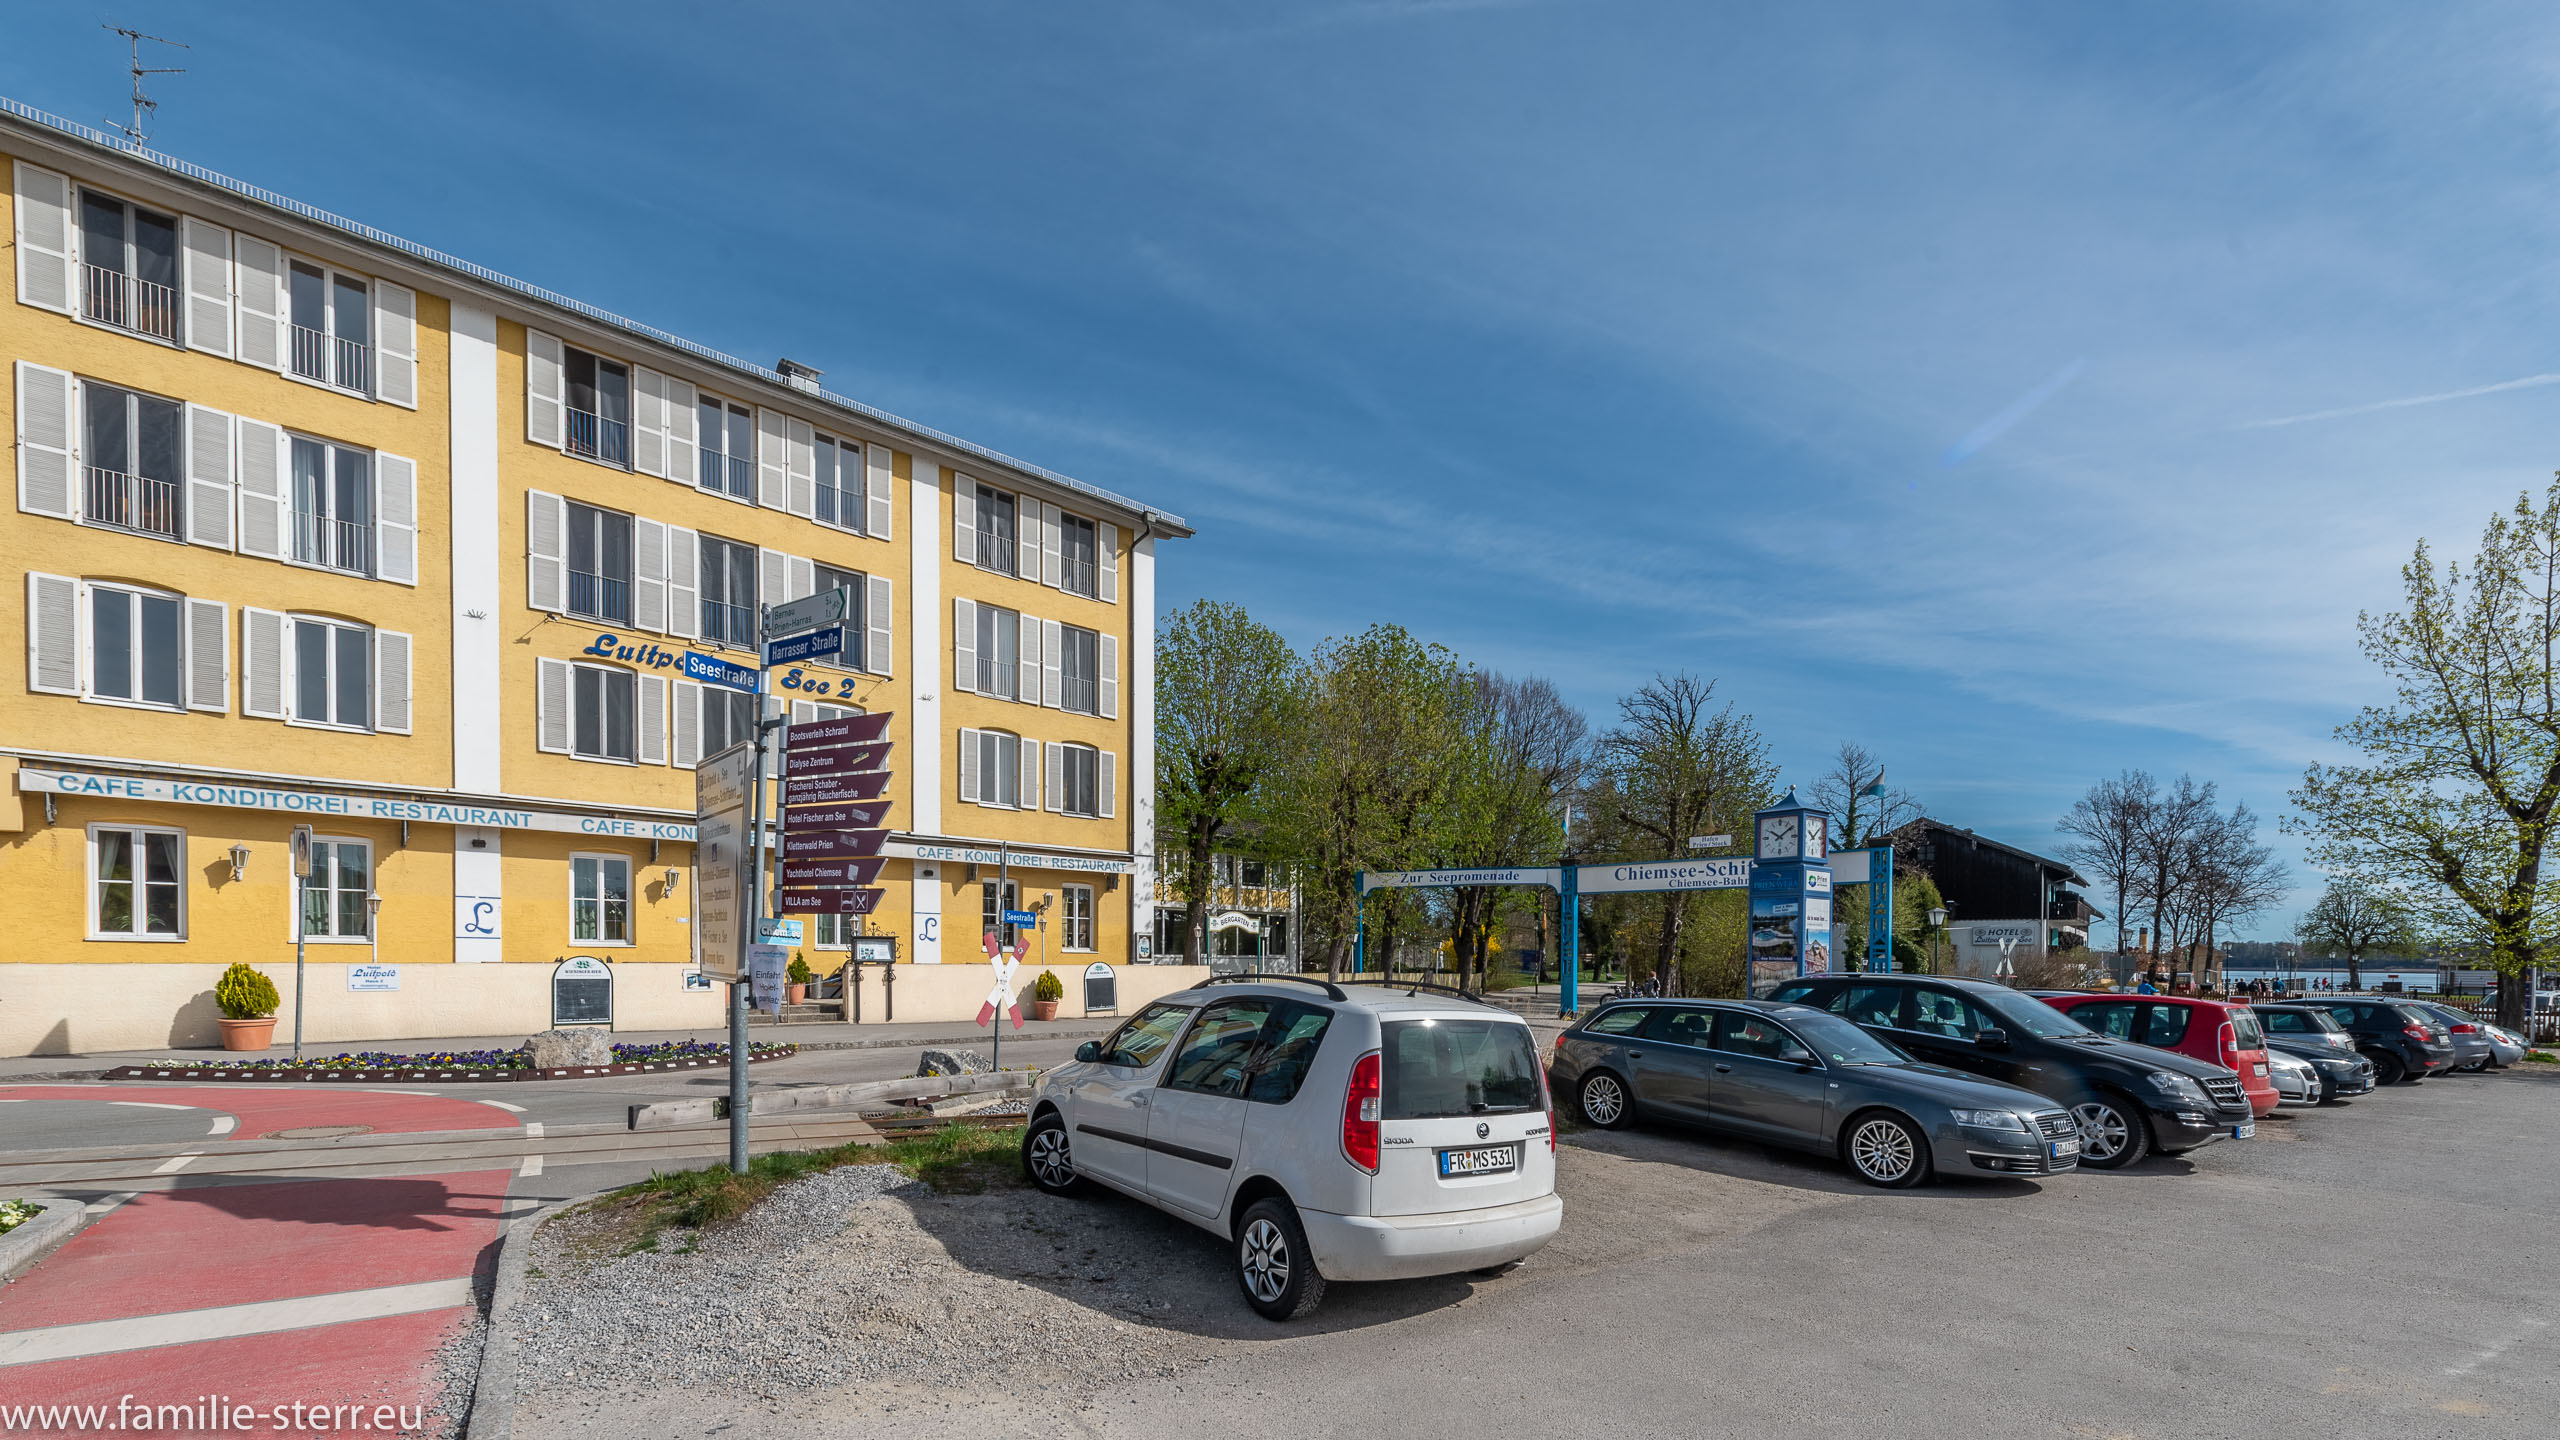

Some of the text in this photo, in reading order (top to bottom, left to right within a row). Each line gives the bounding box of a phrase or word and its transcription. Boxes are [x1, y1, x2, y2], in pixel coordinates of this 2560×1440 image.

[774, 608, 796, 620] Bernau
[774, 615, 812, 632] Prien-Harras
[584, 634, 684, 669] Luitpo
[771, 632, 839, 661] Harrasser Straße
[690, 656, 754, 687] Seestraße
[781, 668, 856, 699] See 2
[790, 725, 849, 741] Bootsverleih Schraml
[789, 757, 834, 770] Dialyse Zentrum
[788, 781, 814, 791] Fischerei
[814, 779, 838, 789] Schaber
[57, 774, 533, 828] CAFE KONDITOREI RESTAURANT
[788, 789, 858, 804] ganzjährig Räucherfische
[787, 814, 802, 824] Hotel
[803, 813, 825, 823] Fischer
[834, 811, 847, 821] See
[581, 818, 636, 836] CAFE
[786, 840, 834, 851] Kletterwald Prien
[917, 846, 1127, 873] CAFE KONDTOREI RESTAURANT
[786, 867, 842, 878] Yachthotel Chiemsee
[1400, 871, 1520, 884] Zur Seepromenade
[785, 896, 801, 906] VILLA
[810, 896, 822, 906] See
[1006, 912, 1034, 922] Seestraße
[1220, 916, 1250, 927] BIERGARTEN
[1988, 928, 2019, 936] HOTEL
[2018, 935, 2032, 943] See
[352, 968, 396, 979] Luitpold
[1491, 1149, 1512, 1167] 531
